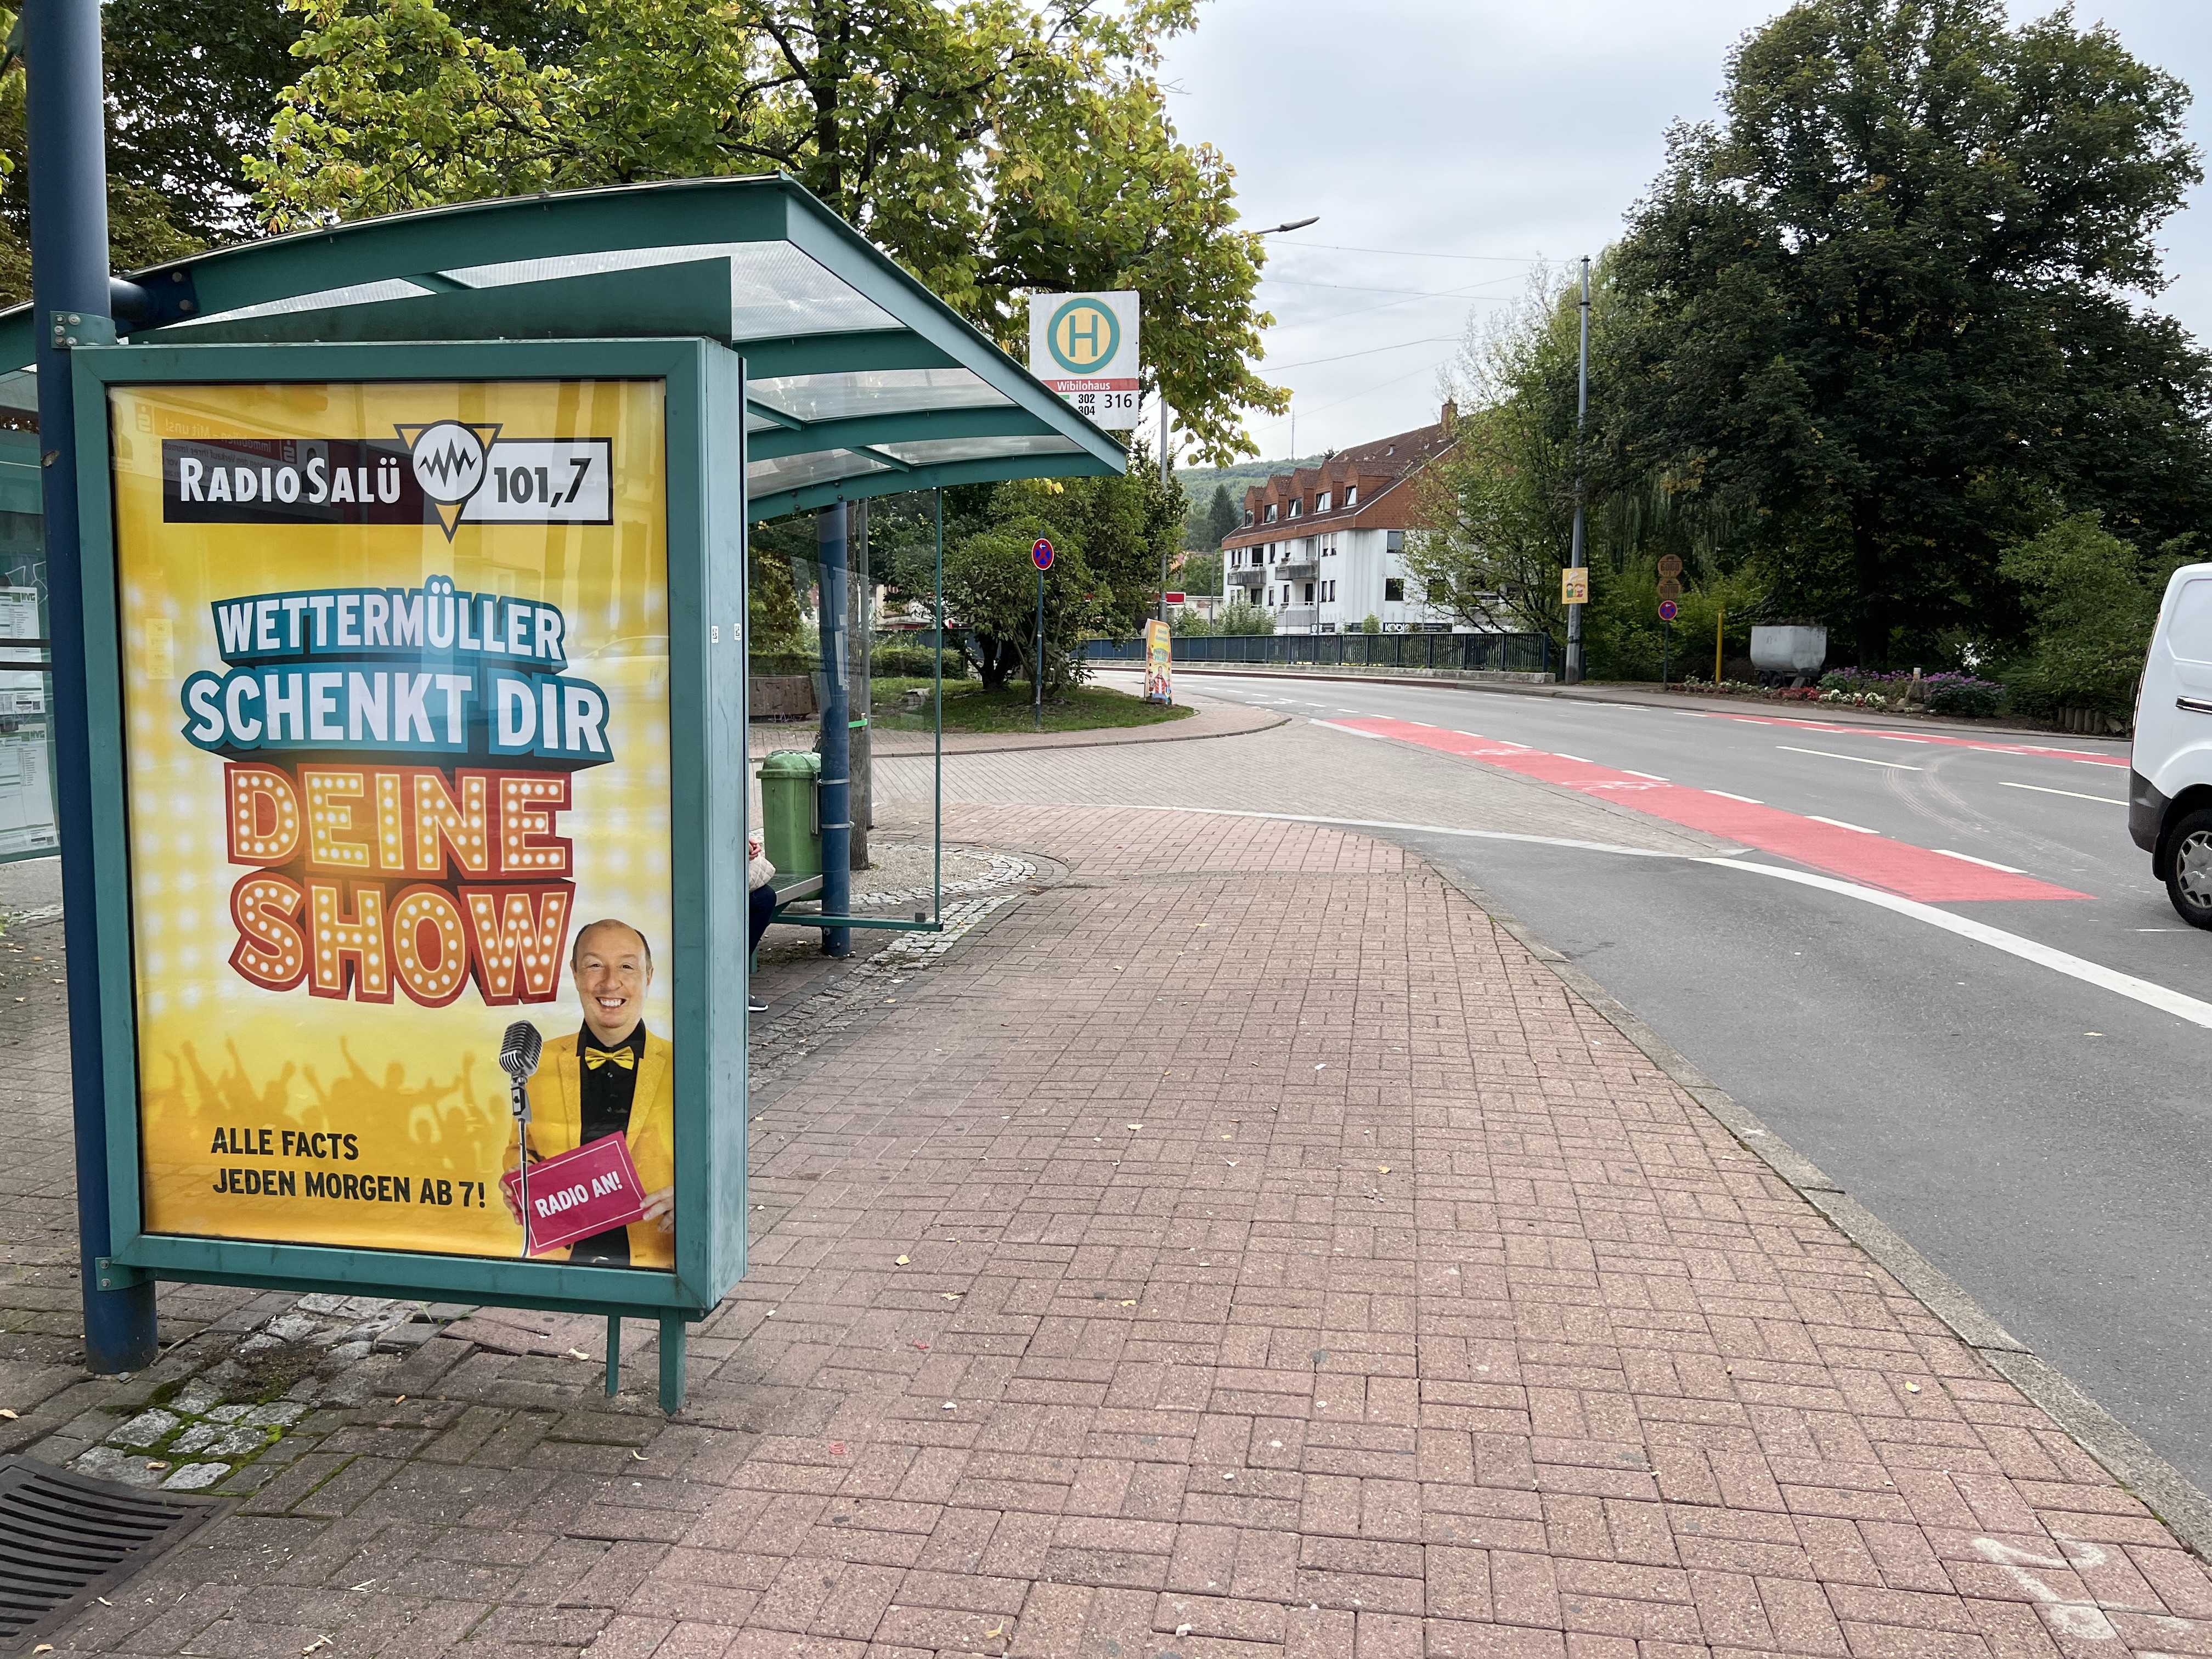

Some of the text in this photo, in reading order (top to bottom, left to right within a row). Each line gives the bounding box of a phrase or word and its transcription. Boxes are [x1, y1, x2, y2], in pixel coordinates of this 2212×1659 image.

[1069, 314, 1098, 357] H
[1057, 381, 1110, 391] Wibilohaus
[1078, 394, 1095, 404] 302
[1104, 393, 1132, 408] 316
[494, 457, 591, 508] 101,7
[218, 582, 562, 660] WETTERMÜLLER
[189, 671, 606, 753] SCHENKT DIR
[230, 769, 566, 872] DEINE
[238, 881, 570, 997] SHOW
[211, 1127, 359, 1160] ALLE FACTS
[212, 1168, 486, 1208] JEDEN MORGEN AB 7!
[535, 1171, 623, 1218] RADIO AN!
